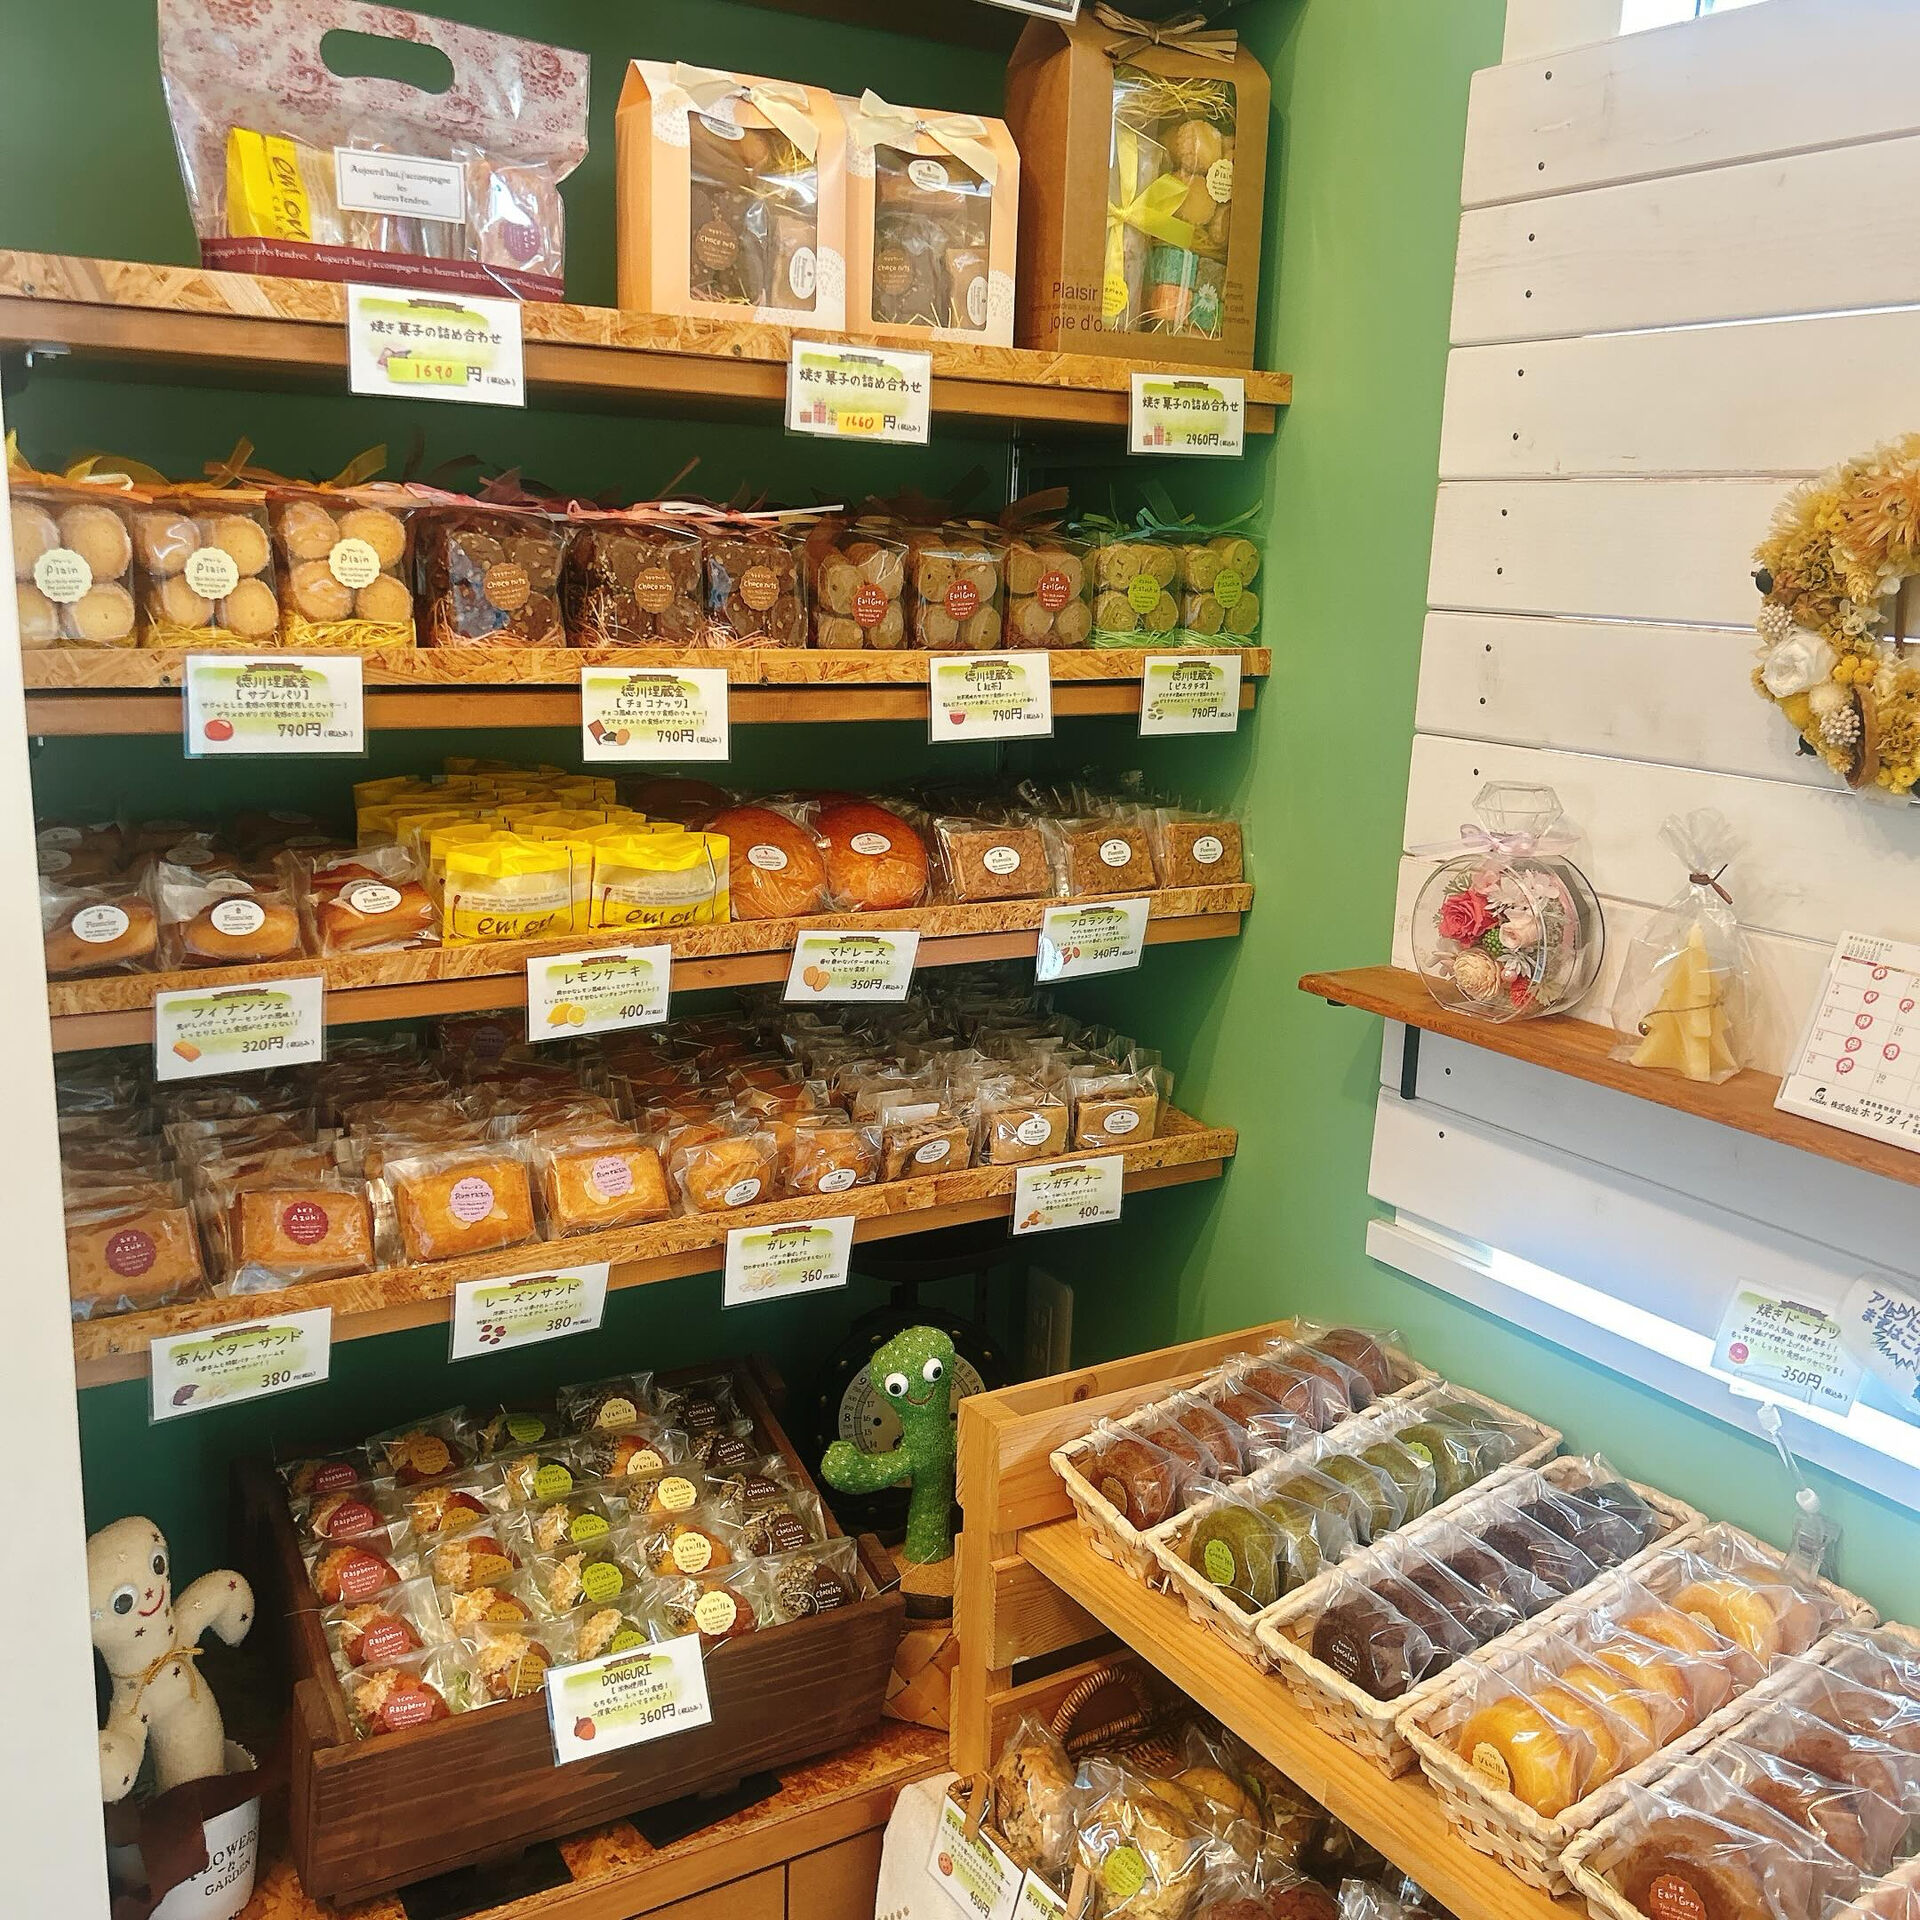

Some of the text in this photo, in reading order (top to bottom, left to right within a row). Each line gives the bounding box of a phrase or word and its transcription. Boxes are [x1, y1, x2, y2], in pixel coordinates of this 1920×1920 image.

[1052, 282, 1098, 301] Plaisir
[1049, 312, 1075, 334] joie
[370, 320, 502, 345] 焼き菓子の詰め合わせ
[415, 364, 453, 379] 1690
[466, 365, 482, 382] 円
[800, 367, 922, 393] 焼き菓子の詰め合わせ
[1142, 396, 1239, 412] 焼き菓子の詰め合わせ
[883, 415, 896, 430] 円
[1186, 433, 1219, 446] 2960円
[341, 553, 370, 564] Plain
[46, 565, 78, 576] Plain
[196, 562, 227, 575] Plain
[236, 674, 312, 689] 徳川埋蔵金
[965, 668, 1016, 682] 徳川埋蔵金
[621, 685, 686, 699] 徳川埋蔵金
[993, 707, 1022, 721] 790円
[1192, 706, 1218, 719] 790円
[277, 722, 321, 737] 790円
[657, 729, 694, 743] 790円
[1070, 915, 1123, 928] フロランタン
[829, 947, 887, 957] マドレーヌ
[1093, 946, 1120, 960] 340円
[564, 965, 641, 985] レモンケーキ
[850, 978, 882, 990] 350円
[191, 1001, 285, 1019] フィナンシェ
[619, 1003, 644, 1019] 400
[241, 1036, 284, 1054] 320円
[1830, 1100, 1909, 1130] 株式会社ホウダイ
[1032, 1175, 1102, 1192] エンガディナー
[291, 1213, 320, 1222] Azuki
[1079, 1205, 1099, 1219] 400
[114, 1242, 147, 1253] Azuki
[767, 1236, 811, 1251] ガレット
[800, 1269, 823, 1284] 360
[486, 1282, 580, 1308] レーズンサンド
[546, 1316, 572, 1332] 380
[1756, 1303, 1842, 1340] 焼きドーナツ
[175, 1329, 305, 1367] あんバターサンド
[261, 1370, 292, 1388] 380
[859, 1377, 867, 1387] 9
[1781, 1365, 1822, 1391] 350円
[867, 1400, 875, 1408] 17
[605, 1407, 633, 1420] Vanilla
[843, 1413, 851, 1421] 8
[717, 1441, 746, 1457] Chocolate
[632, 1461, 660, 1472] Vanilla
[318, 1470, 352, 1484] Raspberry
[663, 1482, 691, 1495] Vanilla
[746, 1485, 776, 1497] Chocolate
[333, 1511, 368, 1527] Raspberry
[775, 1523, 804, 1537] Chocolate
[678, 1542, 706, 1554] Vanilla
[342, 1564, 379, 1579] Raspberry
[701, 1603, 731, 1616] Vanilla
[368, 1630, 404, 1647] Raspberry
[1331, 1644, 1358, 1666] Chocolate
[601, 1663, 653, 1687] DONGURI
[388, 1700, 427, 1714] Raspberry
[640, 1703, 676, 1726] 360円
[1477, 1757, 1505, 1776] Vanilla
[205, 1857, 251, 1896] GARDEN
[1657, 1888, 1678, 1903] Earl
[1678, 1895, 1700, 1912] Grey
